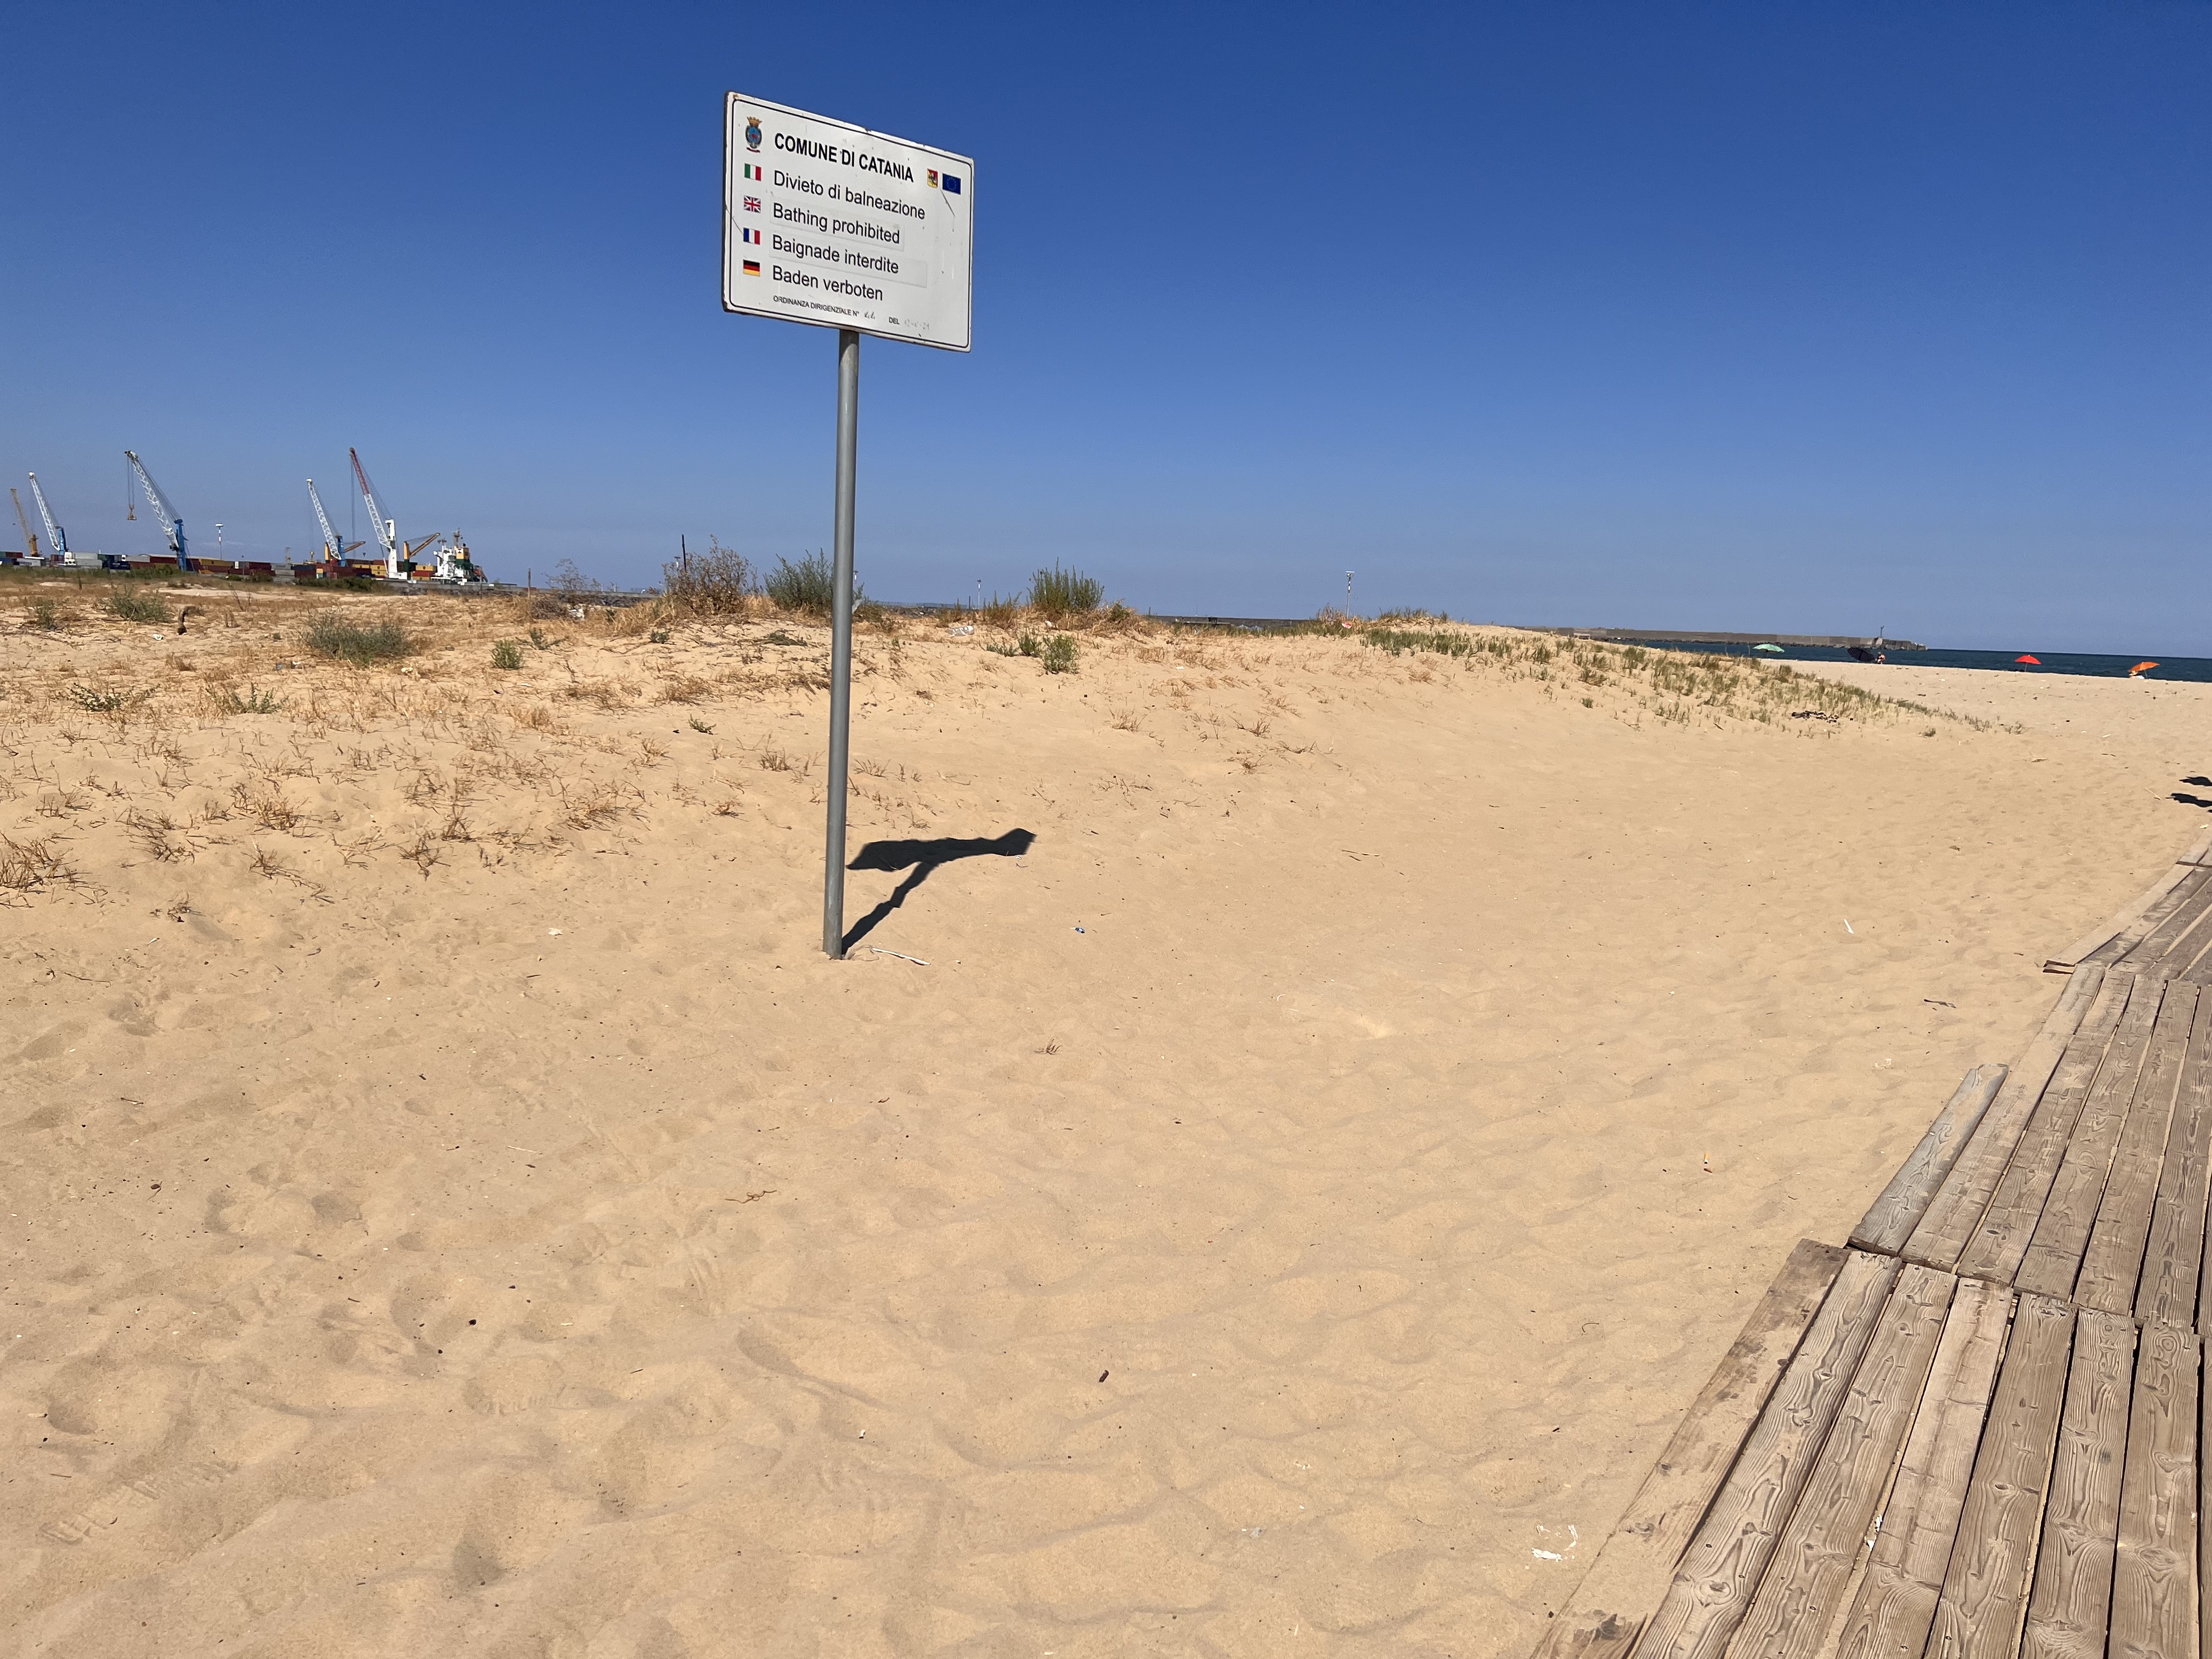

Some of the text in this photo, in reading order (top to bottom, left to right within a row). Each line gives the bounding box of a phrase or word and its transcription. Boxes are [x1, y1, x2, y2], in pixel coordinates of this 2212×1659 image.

[774, 132, 914, 183] COMUNE DI CATANIA
[774, 170, 926, 220] Divieto di balneazione
[773, 202, 900, 245] Bathing prohibited
[772, 234, 899, 274] Baignade interdite
[772, 264, 883, 301] Baden verboten
[773, 295, 810, 308] ORDINANZA
[810, 302, 851, 316] DIRIGENZIALE
[888, 316, 900, 325] DEL
